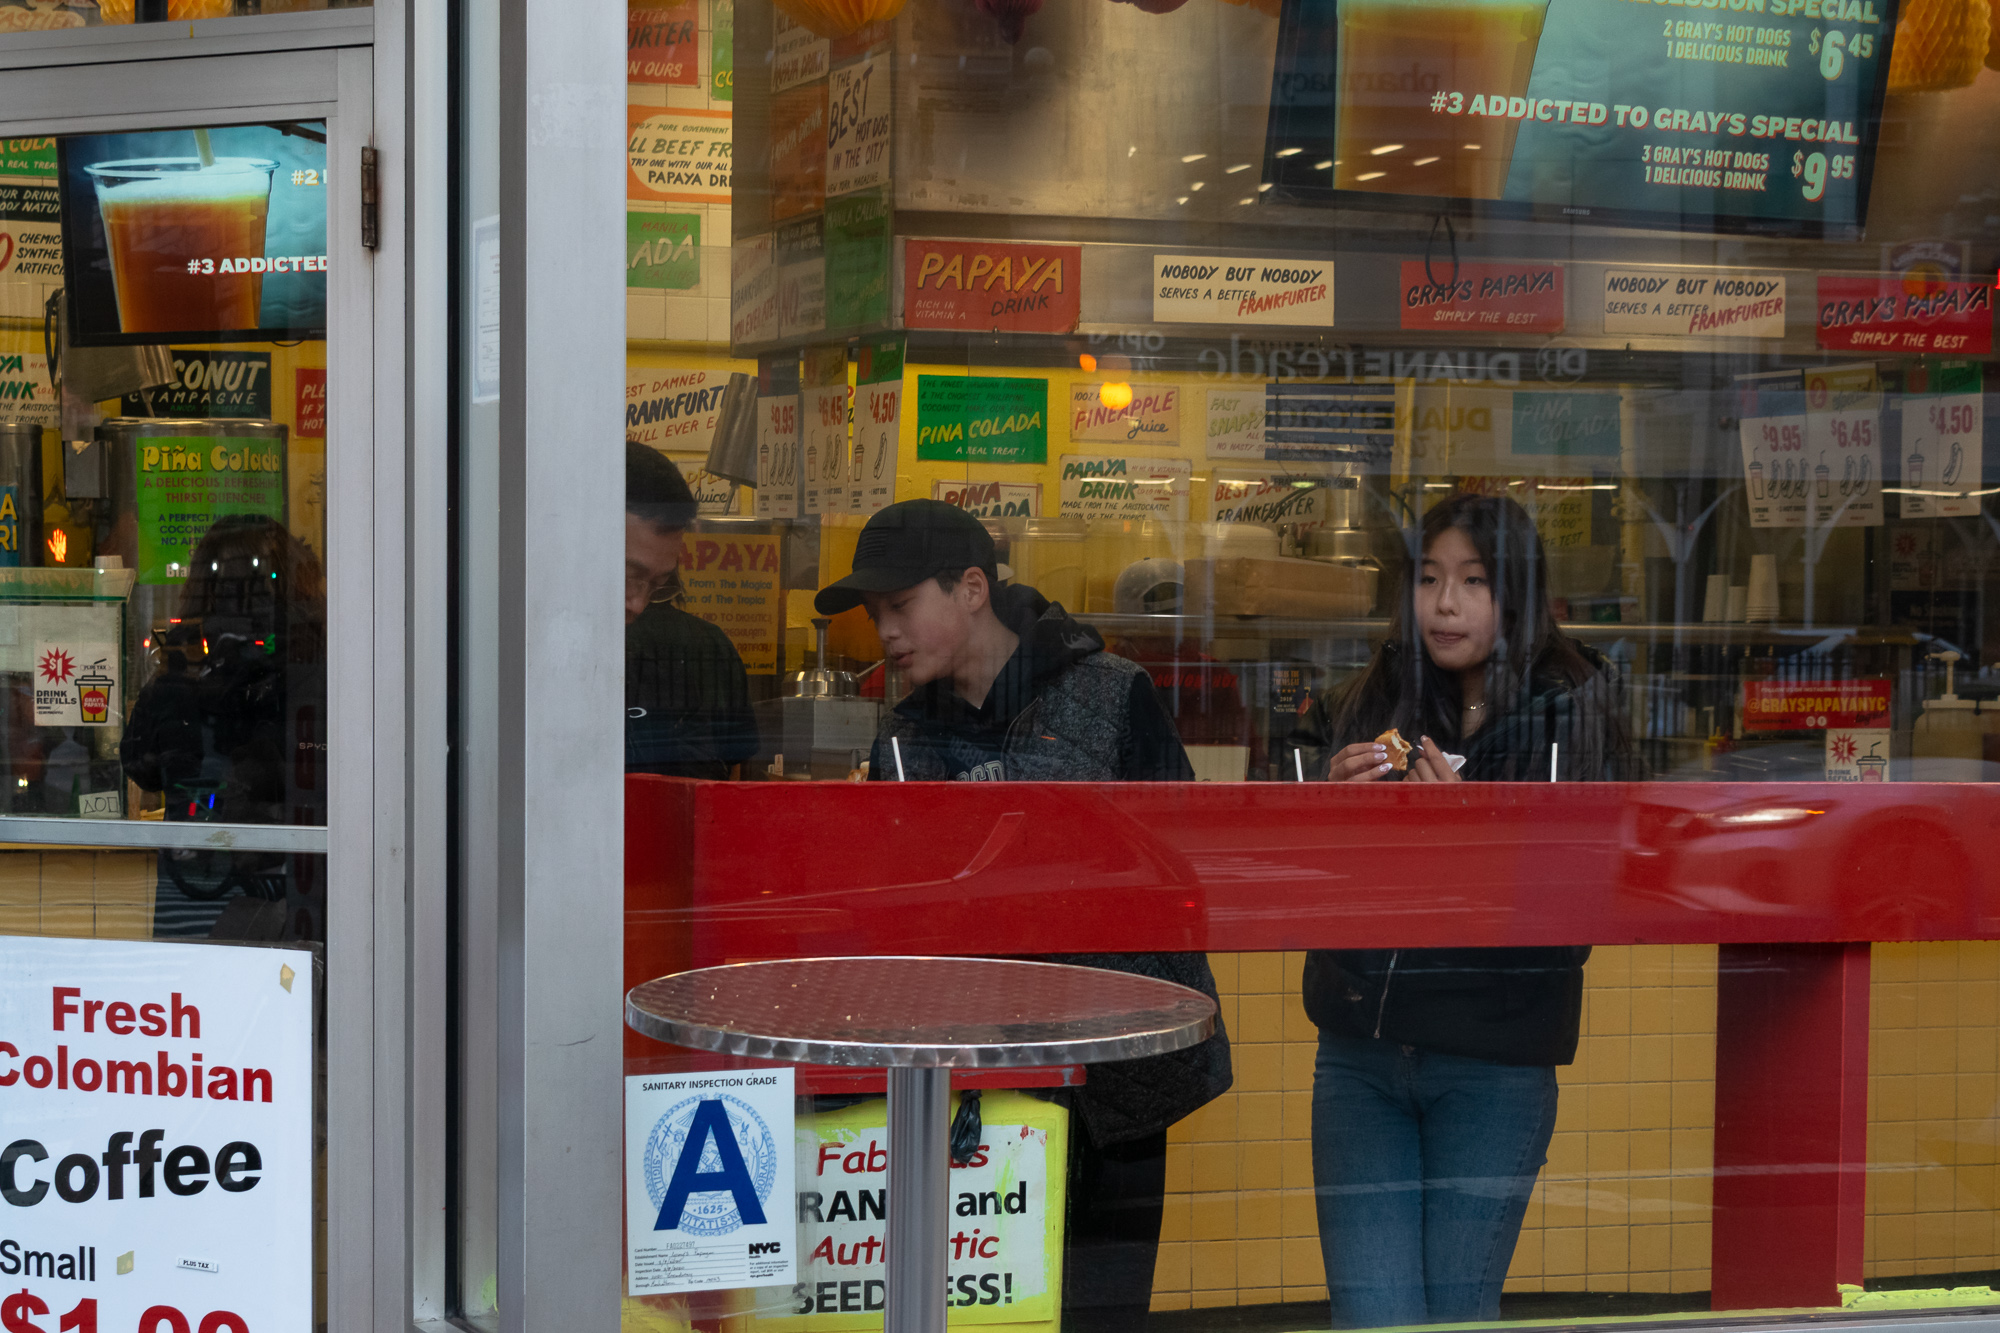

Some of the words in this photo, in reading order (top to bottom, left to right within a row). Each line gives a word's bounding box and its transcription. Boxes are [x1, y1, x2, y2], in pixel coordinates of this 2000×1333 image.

[1769, 0, 1880, 24] SPECIAL
[1663, 19, 1673, 38] 2
[1675, 20, 1724, 41] GRAY'S
[1726, 26, 1755, 44] HOT
[1756, 28, 1791, 47] DOGS
[1666, 41, 1673, 58] 1
[1675, 42, 1744, 64] DELICIOUS
[1745, 48, 1788, 68] DRINK
[644, 61, 683, 78] OURS
[828, 64, 874, 150] BEST
[1430, 90, 1464, 115] #3
[1468, 93, 1607, 127] ADDICTED
[1613, 105, 1648, 128] TO
[1653, 107, 1747, 136] GRAY'S
[1749, 115, 1859, 144] SPECIAL
[657, 123, 678, 131] PURE
[682, 125, 729, 134] GOVERNMENT
[856, 118, 872, 143] HOT
[873, 114, 889, 137] DOG
[652, 138, 704, 156] BEEF
[845, 146, 860, 169] THE
[7, 160, 29, 168] REAL
[631, 158, 648, 167] TRY
[650, 159, 666, 168] ONE
[668, 160, 691, 169] WITH
[695, 161, 712, 170] OUR
[715, 163, 727, 171] ALL
[1642, 145, 1651, 162] 3
[1653, 146, 1702, 165] GRAY'S
[1703, 149, 1733, 167] HOT
[1734, 152, 1770, 171] DOGS
[292, 169, 318, 185] #2
[648, 170, 703, 187] PAPAYA
[1645, 166, 1651, 183] 1
[1653, 166, 1722, 188] DELICIOUS
[1723, 171, 1766, 191] DRINK
[641, 222, 688, 234] MANILA
[188, 259, 214, 275] #3
[219, 256, 327, 274] ADDICTED
[917, 252, 1064, 294] PAPAYA
[1161, 265, 1219, 280] NOBODY
[1225, 266, 1256, 281] BUT
[1260, 267, 1323, 284] NOBODY
[1479, 271, 1555, 299] PAPAYA
[1607, 277, 1669, 293] NOBODY
[1675, 278, 1708, 294] BUT
[1713, 279, 1779, 297] NOBODY
[916, 300, 940, 309] RICH
[944, 300, 954, 309] IN
[991, 294, 1049, 317] DRINK
[1159, 287, 1199, 299] SERVES
[1203, 288, 1212, 300] A
[1217, 289, 1257, 301] BETTER
[1237, 284, 1327, 317] FRANKFURTER
[1903, 285, 1991, 320] PAPAYA
[916, 311, 955, 319] VITAMIN
[958, 312, 966, 320] A
[1433, 310, 1475, 322] SIMPLY
[1479, 312, 1500, 323] THE
[1506, 312, 1538, 324] BEST
[1605, 302, 1646, 314] SERVES
[1652, 303, 1661, 315] A
[1667, 304, 1708, 316] BETTER
[1688, 297, 1783, 334] FRANKFURTER
[1850, 331, 1898, 345] SIMPLY
[1902, 333, 1927, 347] THE
[1933, 334, 1968, 348] BEST
[652, 372, 706, 393] DAMNED
[626, 384, 729, 428] RANKFURT
[870, 391, 896, 424] $4.50
[1075, 391, 1175, 431] PINEAPPLE
[1210, 398, 1241, 411] FAST
[15, 415, 48, 423] TROPICS
[665, 419, 699, 437] EVER
[771, 404, 794, 434] $9.95
[918, 422, 963, 446] PINA
[968, 411, 1041, 438] COLADA
[1208, 410, 1269, 438] SNAPPY
[1929, 404, 1973, 435] $4.50
[1831, 419, 1872, 448] $6.45
[140, 445, 203, 473] Piña
[210, 445, 280, 474] Colada
[955, 446, 962, 454] A
[966, 446, 987, 455] REAL
[992, 446, 1018, 455] TREAT
[1062, 459, 1127, 480] PAPAYA
[144, 478, 152, 488] A
[156, 477, 220, 488] DELICIOUS
[1079, 481, 1139, 500] DRINK
[165, 493, 203, 503] THIRST
[943, 481, 1001, 508] PINA
[1062, 500, 1082, 509] MADE
[1085, 501, 1102, 509] FROM
[1105, 502, 1118, 510] THE
[1122, 502, 1169, 511] ARISTOCRATIC
[1216, 497, 1314, 523] FRANKFURTER
[158, 514, 165, 522] A
[169, 514, 209, 523] PERFECT
[161, 537, 178, 545] NO
[689, 579, 715, 588] From
[720, 580, 736, 589] The
[741, 581, 772, 591] Magical
[701, 594, 712, 603] of
[716, 595, 733, 604] The
[49, 657, 63, 677] $1
[1749, 697, 1886, 713] @GRAYSPAPAYANYC
[52, 986, 200, 1039] Fresh
[0, 1041, 273, 1103] Colombian
[642, 1081, 687, 1091] SANITARY
[689, 1078, 743, 1088] INSPECTION
[746, 1077, 777, 1086] GRADE
[0, 1129, 262, 1208] Coffee
[653, 1100, 768, 1231] A
[955, 1180, 1027, 1217] and
[697, 1205, 724, 1215] 1625
[749, 1242, 781, 1255] NYC
[809, 1228, 1000, 1266] Auttic
[0, 1239, 96, 1282] Small
[198, 1261, 210, 1269] TAX
[792, 1273, 1012, 1315] SEEDSS!
